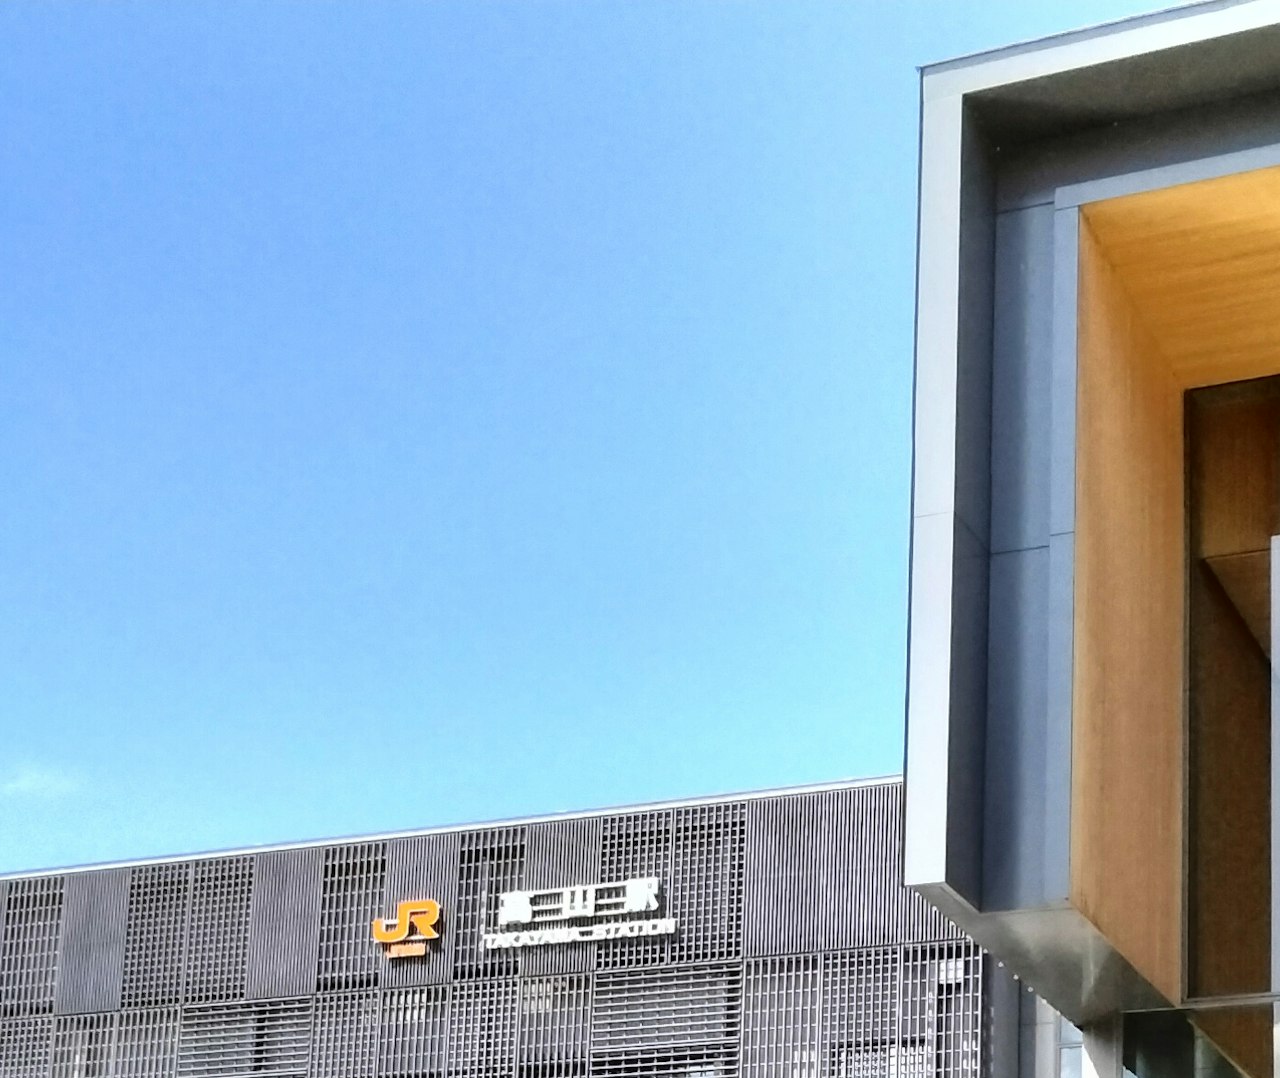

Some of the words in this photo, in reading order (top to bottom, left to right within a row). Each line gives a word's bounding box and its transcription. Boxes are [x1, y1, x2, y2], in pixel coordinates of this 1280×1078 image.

[372, 898, 441, 944] JR
[483, 928, 578, 949] TAKAYAMA
[593, 918, 677, 941] STATION
